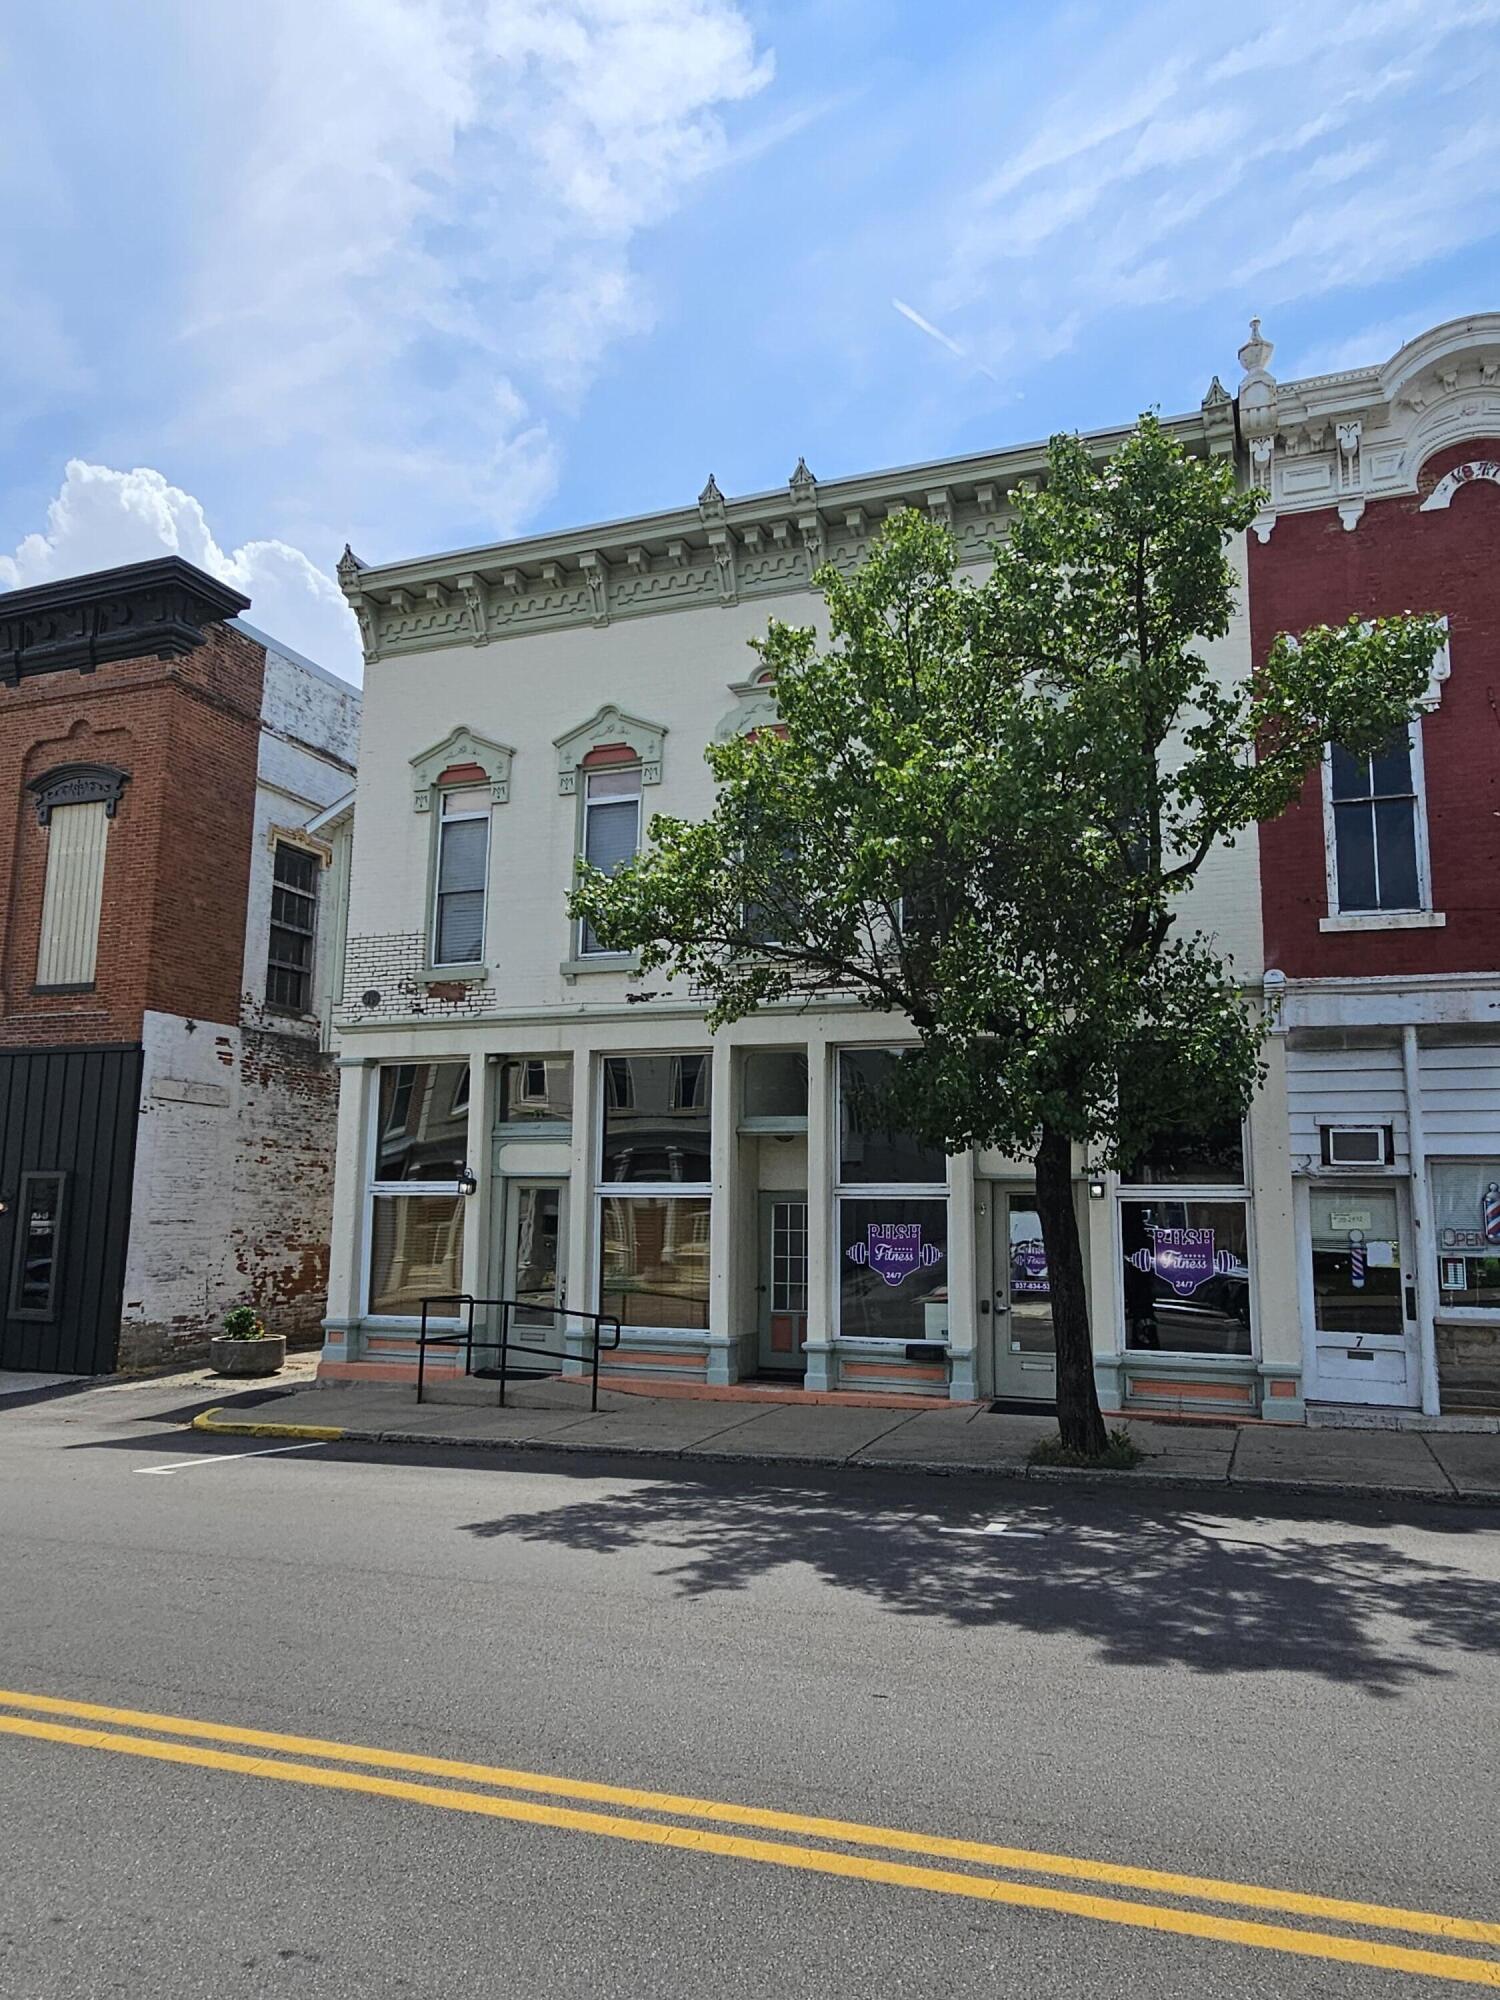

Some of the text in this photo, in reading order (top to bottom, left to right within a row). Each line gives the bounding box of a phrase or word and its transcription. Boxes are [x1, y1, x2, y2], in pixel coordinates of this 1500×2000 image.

[868, 1223, 921, 1239] RUSH
[1153, 1228, 1215, 1245] RUSH
[1443, 1228, 1485, 1246] OPEN
[875, 1243, 914, 1261] Fitness
[1161, 1250, 1207, 1268] Fitness
[886, 1271, 902, 1279] 24/7
[1015, 1282, 1050, 1290] 937-834-53
[1175, 1280, 1194, 1288] 24/7
[1355, 1335, 1364, 1347] 7
